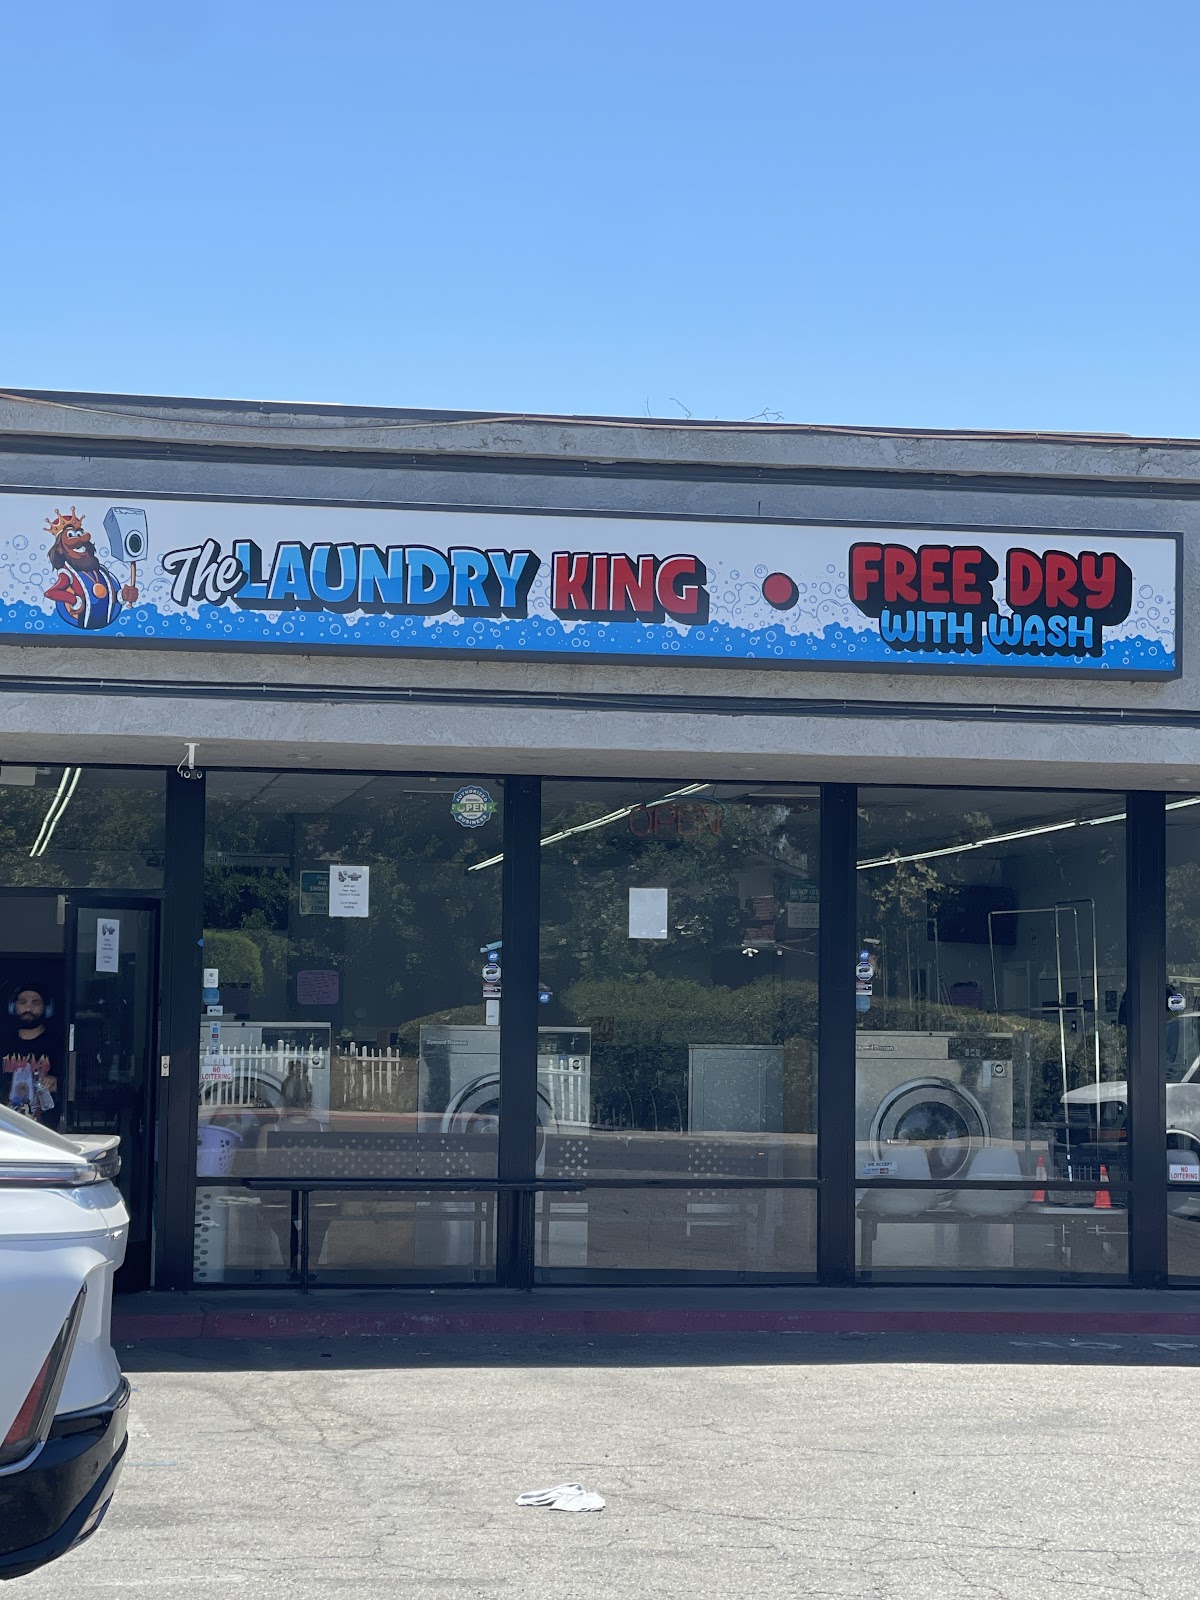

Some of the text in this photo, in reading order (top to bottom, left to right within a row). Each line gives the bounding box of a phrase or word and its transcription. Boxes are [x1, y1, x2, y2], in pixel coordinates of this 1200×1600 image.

[163, 539, 701, 615] The LAUNDRY KING
[851, 545, 1117, 610] FREE DRY
[880, 609, 1094, 649] WITH WASH
[457, 789, 488, 802] AUTHORIZED
[457, 803, 488, 812] OPEN
[458, 815, 487, 824] BUSINESS
[628, 804, 722, 836] OPEN
